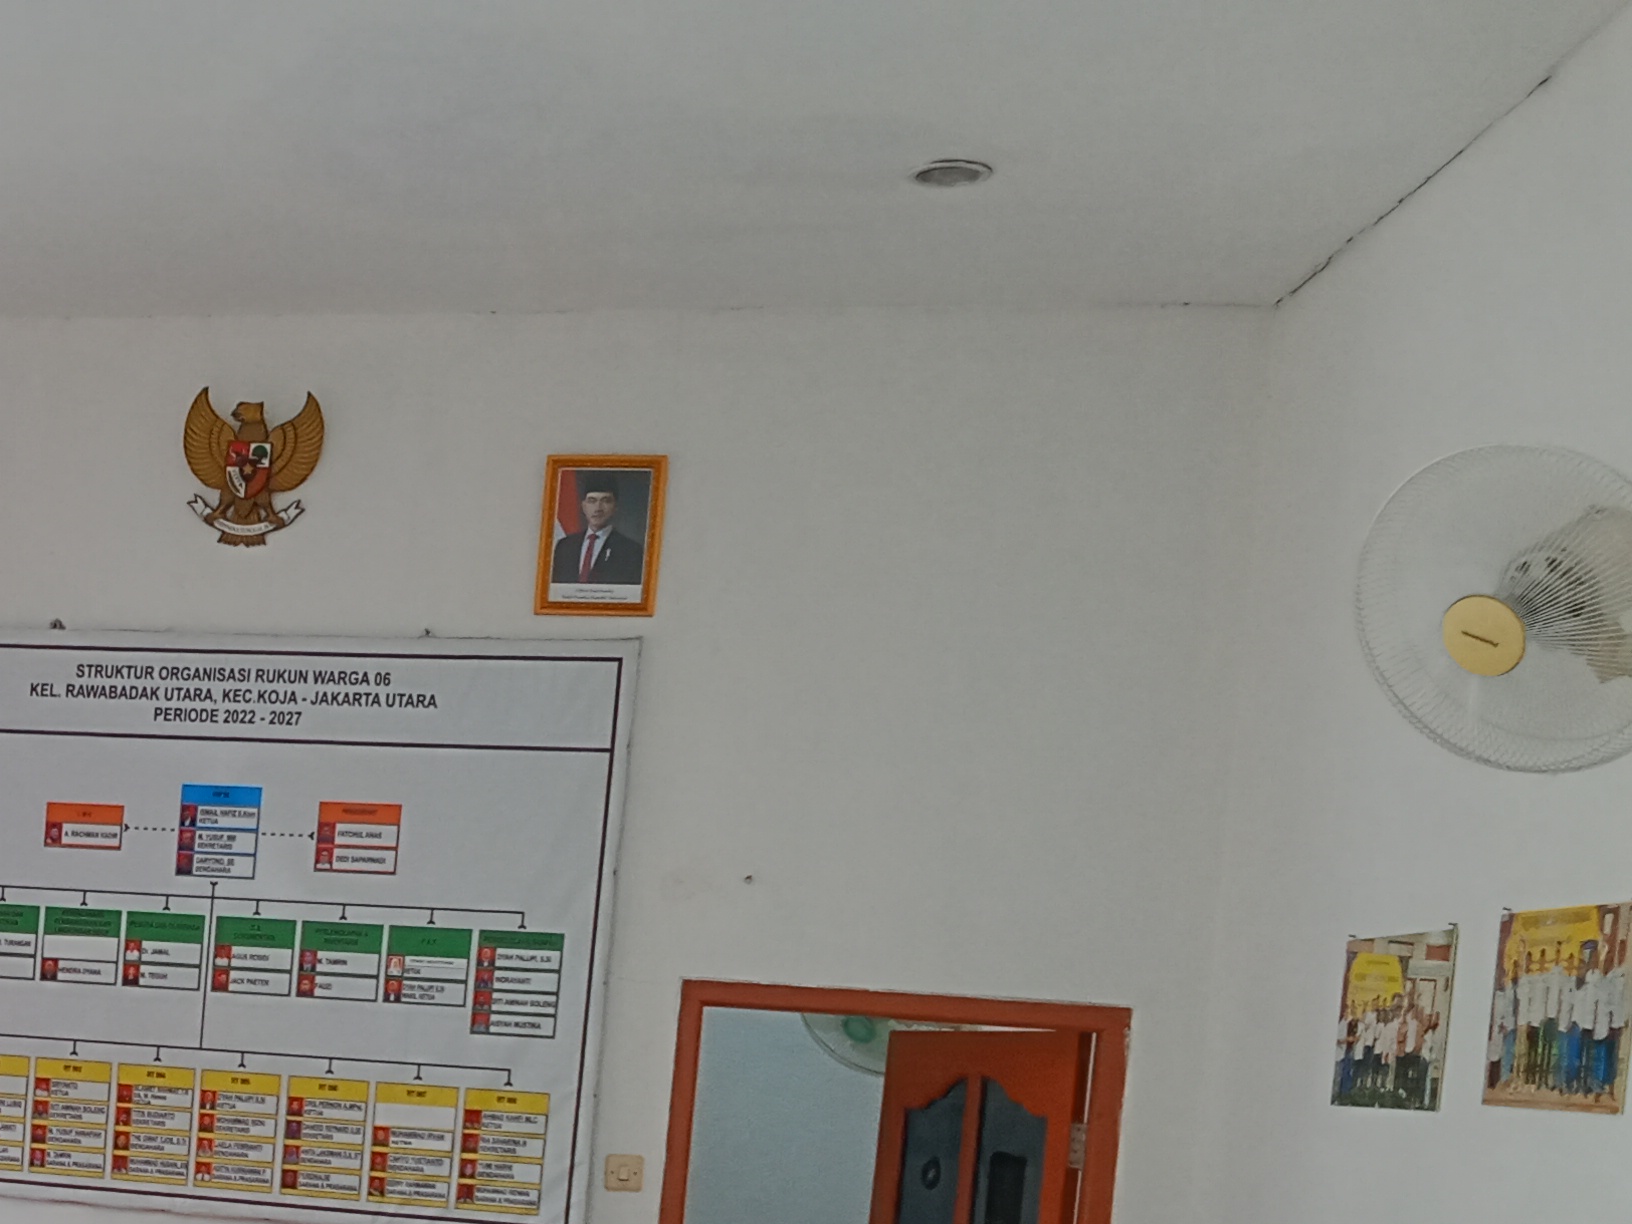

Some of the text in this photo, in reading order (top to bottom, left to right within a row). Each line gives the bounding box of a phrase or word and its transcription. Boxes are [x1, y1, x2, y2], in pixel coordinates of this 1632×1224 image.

[75, 664, 392, 688] STRUKTUR ORGANISASI RUKUN WARGA 06
[29, 682, 62, 698] KEL.
[65, 684, 160, 702] RAWABADAK
[164, 686, 218, 704] UTARA,
[310, 690, 382, 708] JAKARTA
[386, 692, 439, 710] UTARA
[153, 707, 219, 724] PERIODE
[223, 709, 256, 725] 2022
[269, 711, 303, 727] 2027
